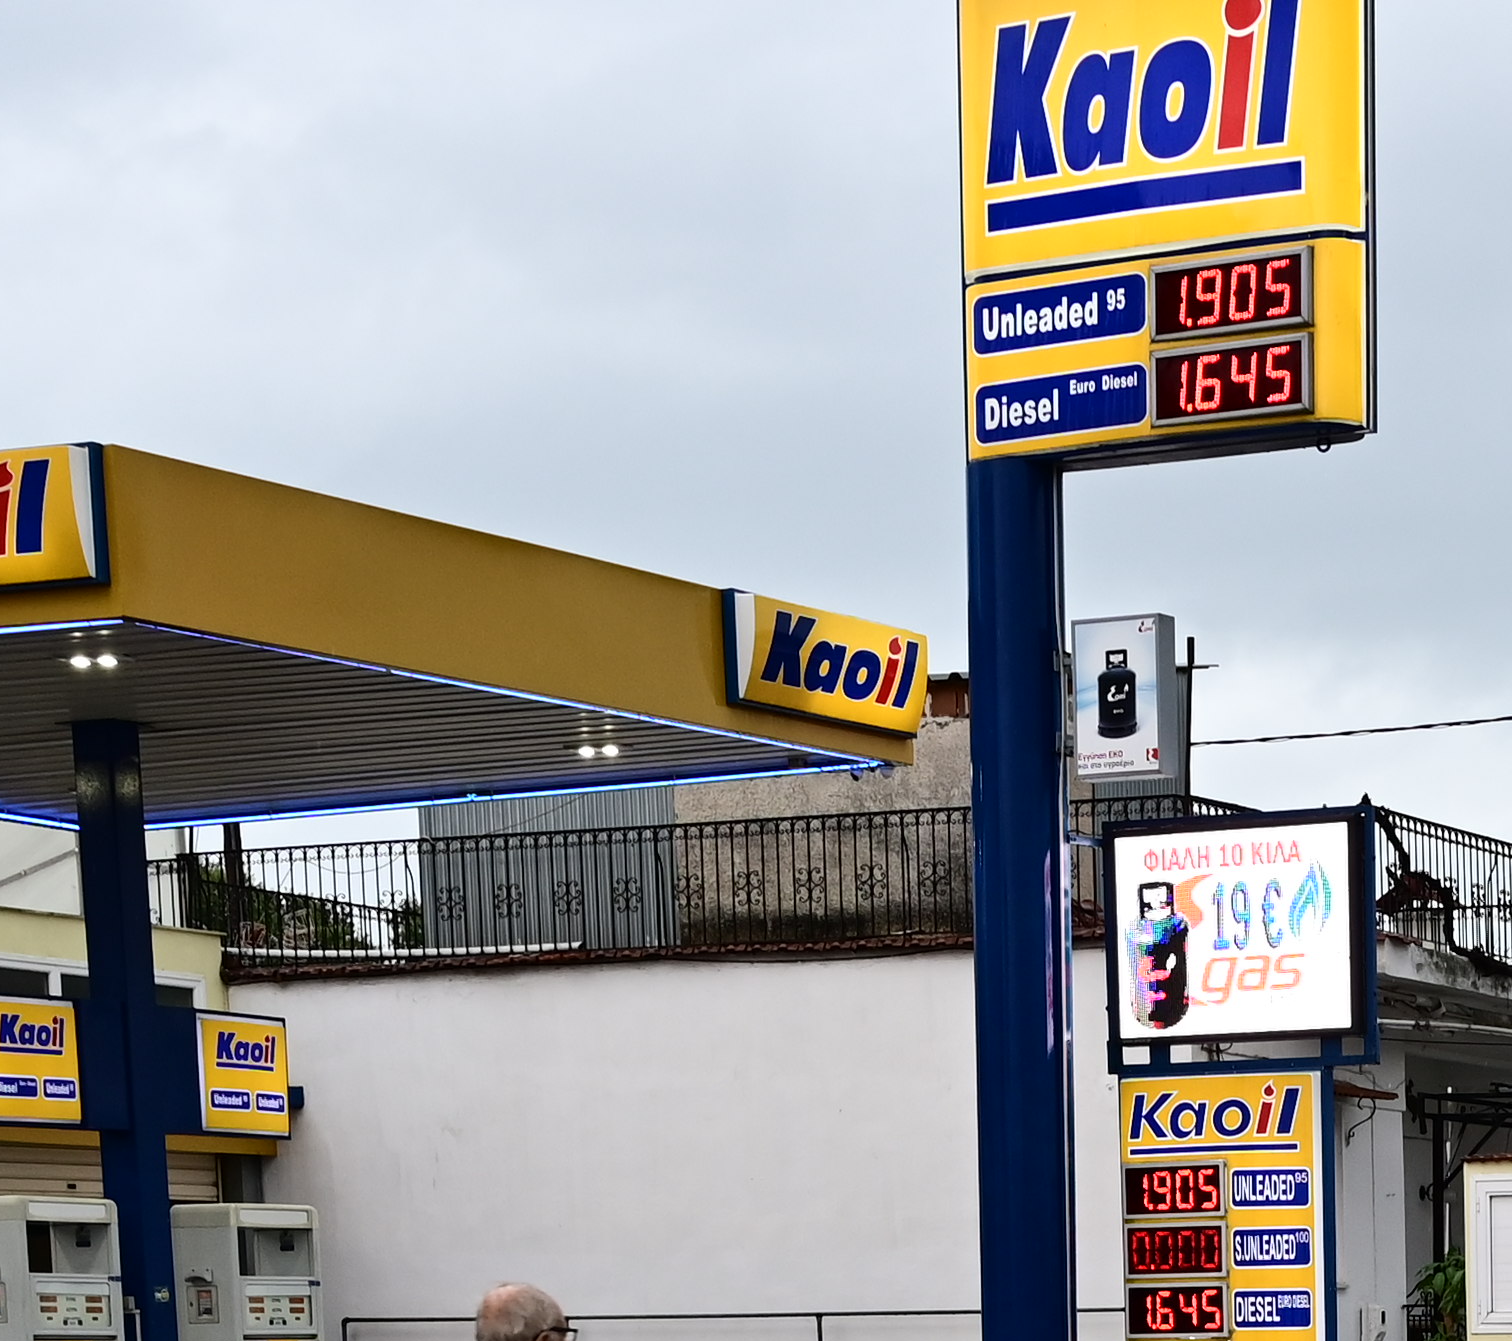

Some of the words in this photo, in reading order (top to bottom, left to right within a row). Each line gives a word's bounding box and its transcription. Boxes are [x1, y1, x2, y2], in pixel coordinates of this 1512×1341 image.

[985, 0, 1300, 187] Kaoil
[982, 291, 1098, 341] Unleaded
[1106, 287, 1127, 312] 95
[1179, 257, 1291, 327] 1.905
[984, 388, 1060, 431] Diesel
[1069, 377, 1096, 395] Euro
[1101, 370, 1138, 391] Diesel
[1179, 344, 1291, 413] 1.645
[760, 609, 920, 710] Kaoil
[1144, 845, 1210, 872] ΦΙΑΛΗ
[1219, 844, 1243, 867] 10
[1251, 840, 1302, 865] ΚΙΛΑ
[1201, 953, 1304, 1004] gas
[216, 1031, 276, 1064] Kaoil
[1129, 1080, 1302, 1140] Kaoil
[1143, 1168, 1217, 1211] 1.905
[1234, 1174, 1295, 1201] UNLEADED
[1295, 1172, 1308, 1184] 95
[1235, 1234, 1296, 1261] S.UNLEADED
[1145, 1289, 1222, 1330] 1.645
[1236, 1296, 1280, 1322] DIESEL
